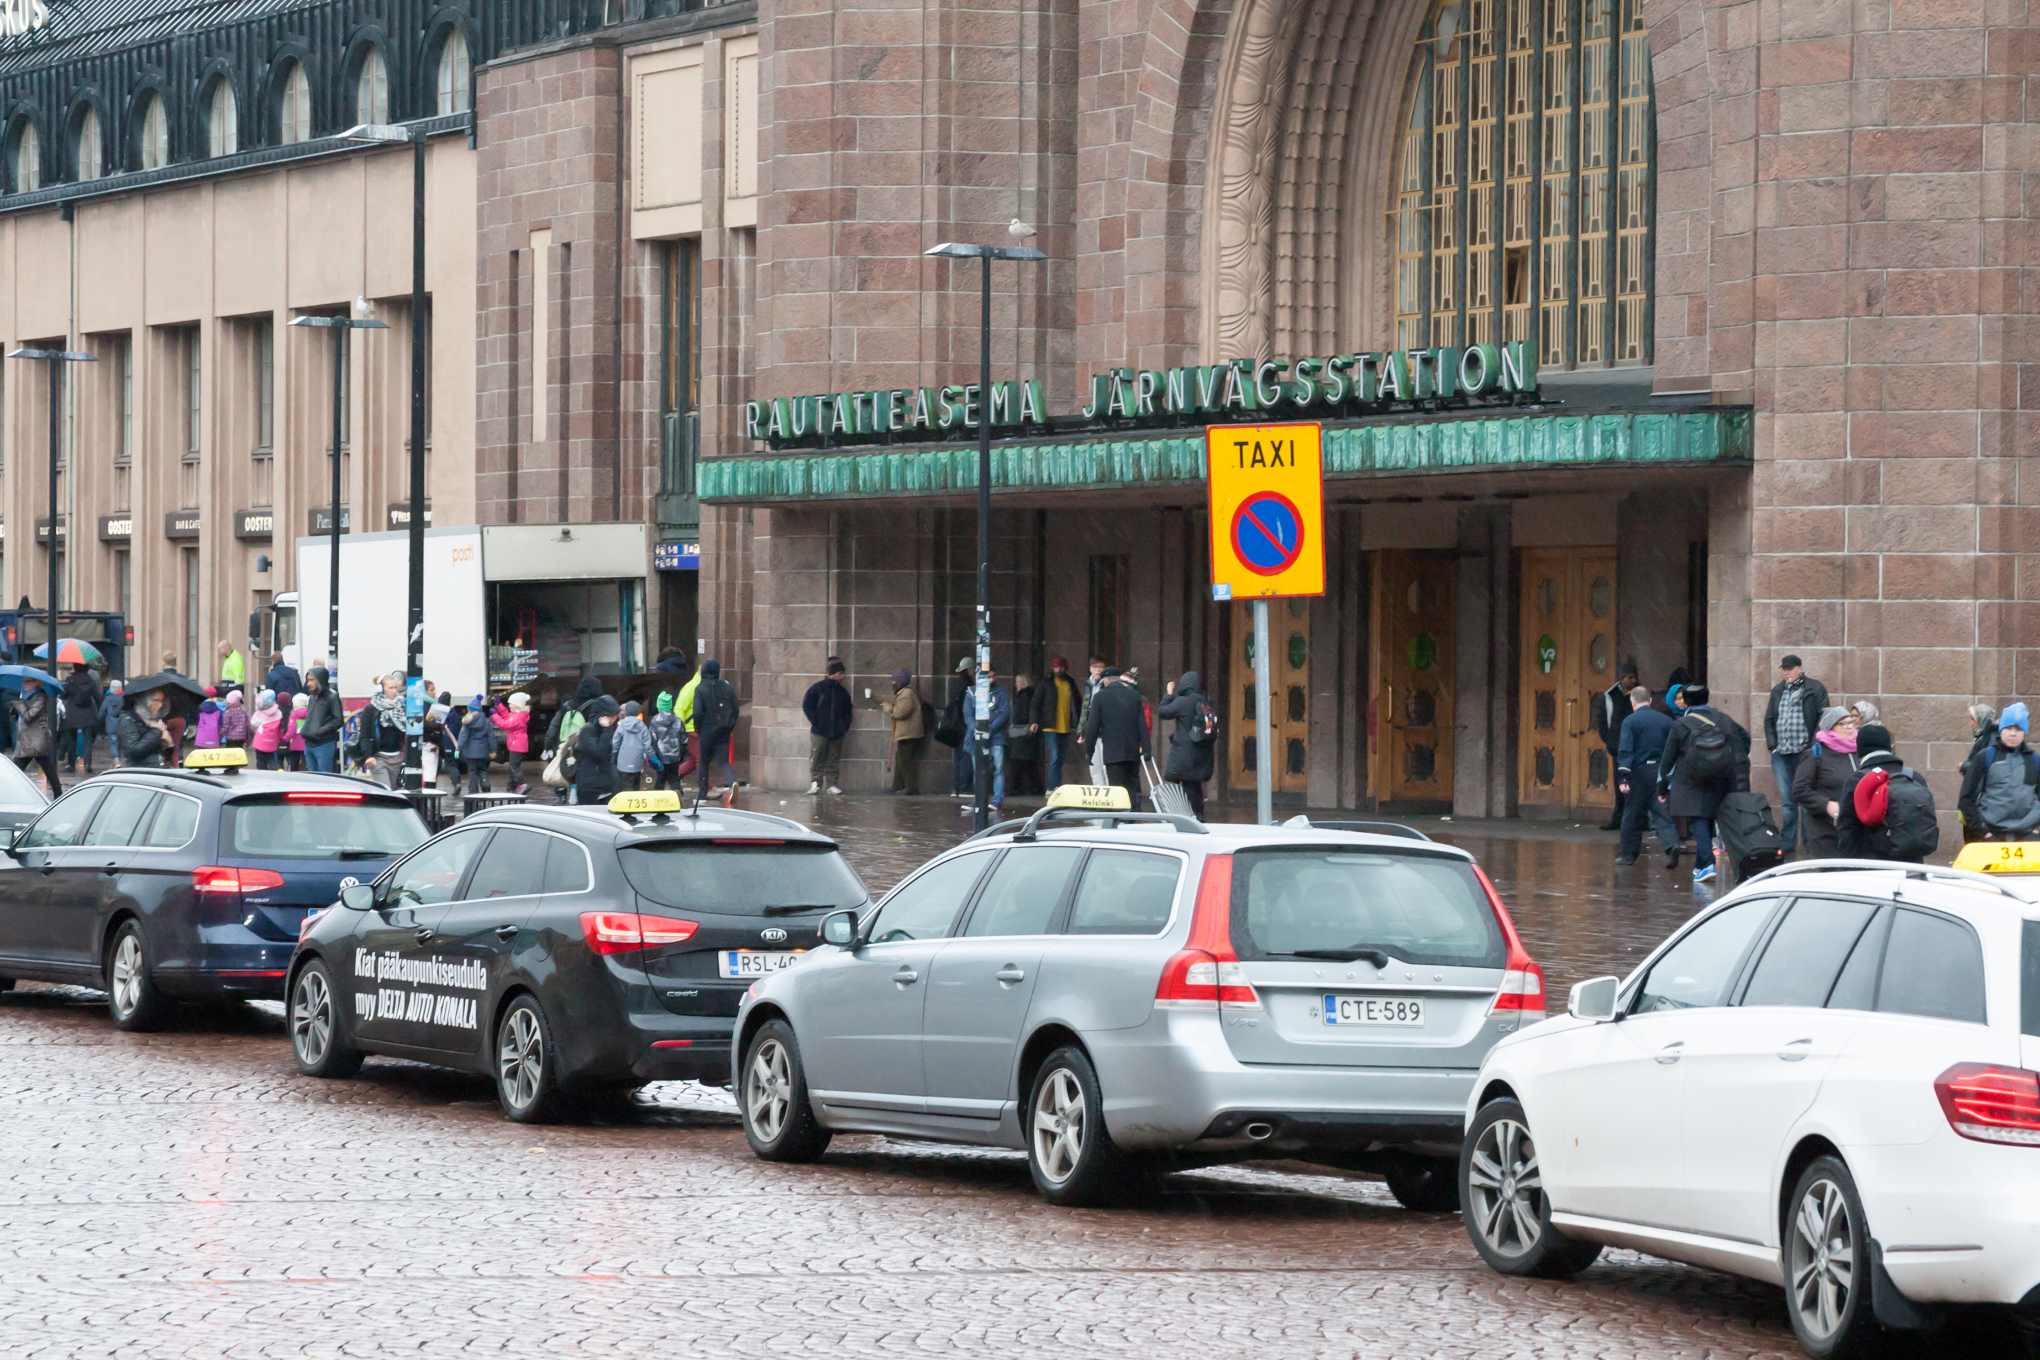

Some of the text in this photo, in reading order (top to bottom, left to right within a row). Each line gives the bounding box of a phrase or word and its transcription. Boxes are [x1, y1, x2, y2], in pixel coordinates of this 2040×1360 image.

[1082, 339, 1536, 420] JÄRNVÄGSSTATION
[746, 380, 1044, 440] RAUTATIEASEMA
[1233, 440, 1295, 468] TAXI
[626, 798, 648, 809] 735
[1080, 786, 1112, 797] 1177
[2000, 847, 2024, 859] 34
[354, 947, 487, 990] Kiat pääkaupunkiseudulla
[355, 988, 477, 1029] myy DELTA AUTO KONALA
[1340, 1000, 1421, 1021] CTE-589
